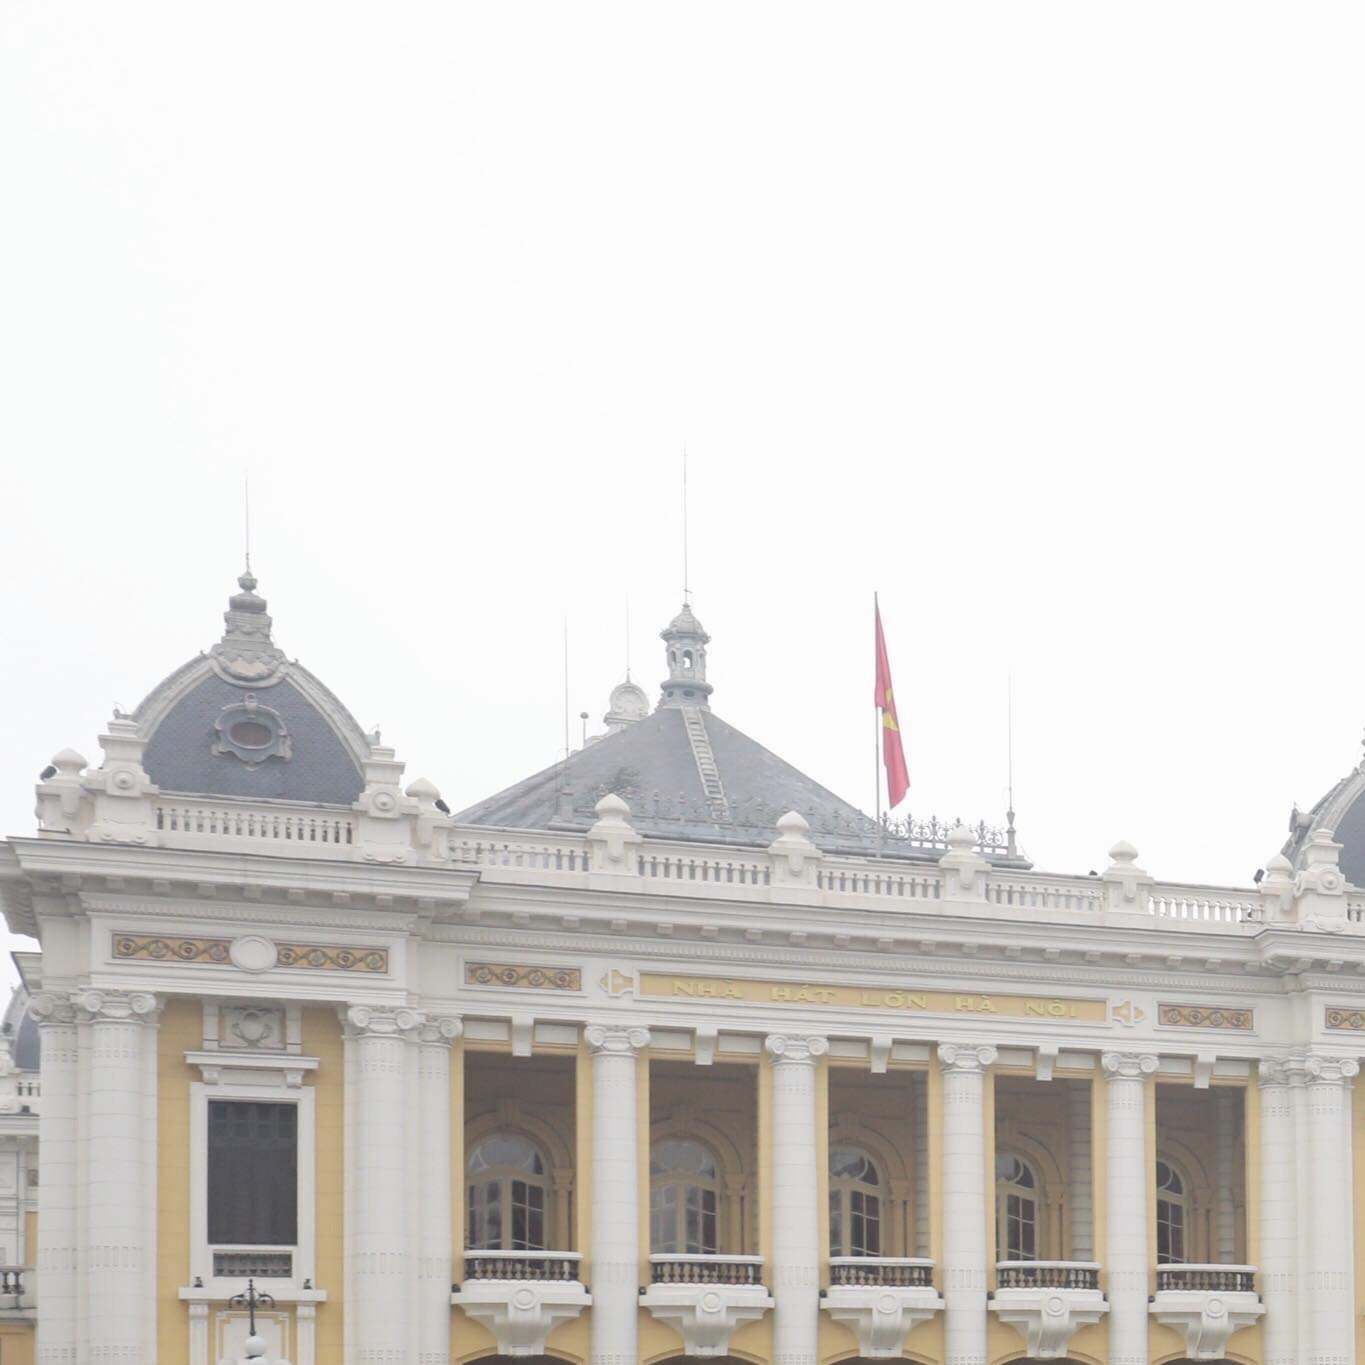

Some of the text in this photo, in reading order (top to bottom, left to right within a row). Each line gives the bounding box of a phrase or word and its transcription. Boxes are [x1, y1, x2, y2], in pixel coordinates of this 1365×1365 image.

[671, 979, 743, 999] NHÀ
[768, 984, 836, 1004] HÁT
[953, 995, 999, 1014] HÀ
